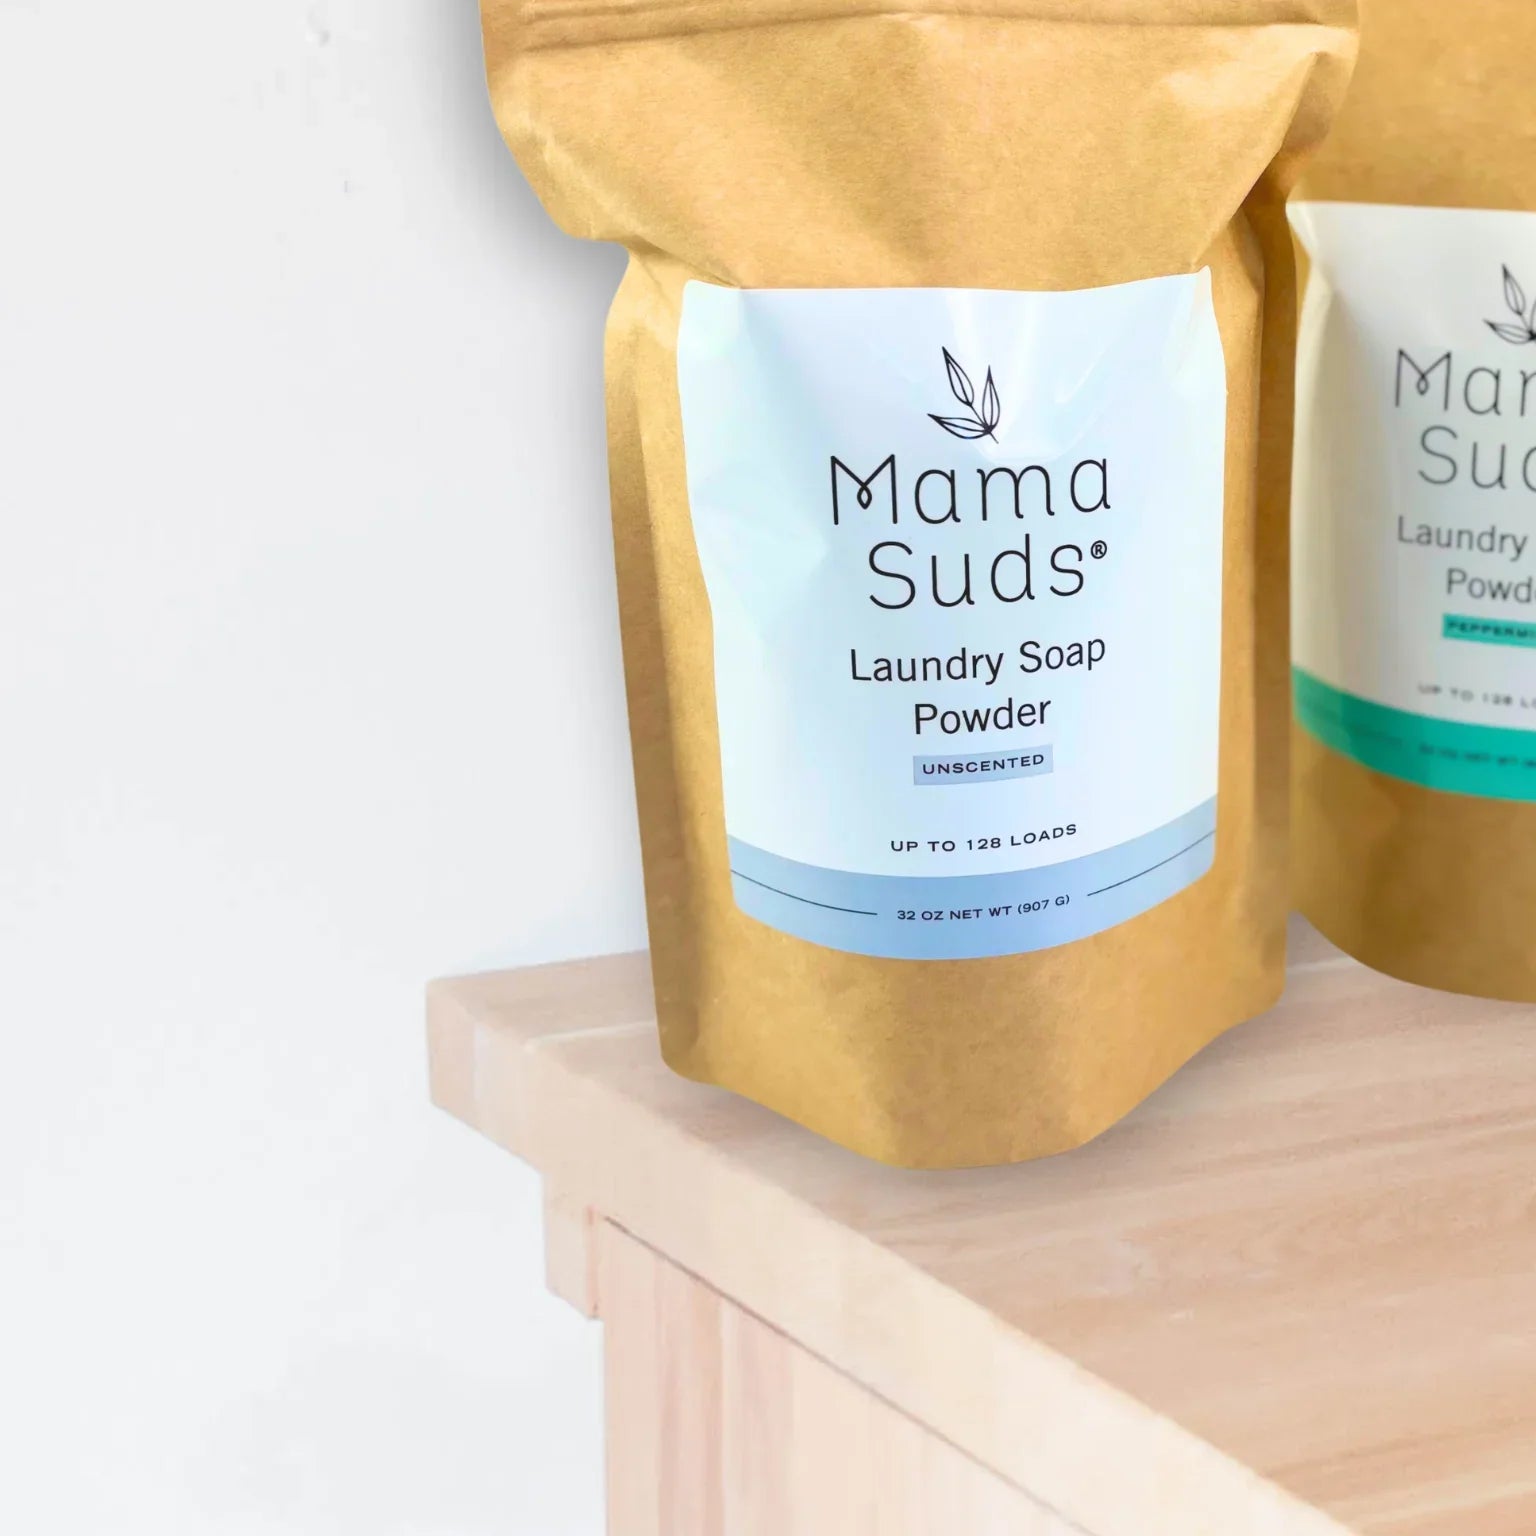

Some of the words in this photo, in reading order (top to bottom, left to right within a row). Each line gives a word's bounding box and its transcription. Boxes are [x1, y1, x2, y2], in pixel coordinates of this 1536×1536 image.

[829, 453, 1111, 526] Mama
[1397, 514, 1528, 563] Laundry
[850, 645, 1004, 686] Laundry
[1018, 637, 1106, 676] Soap
[914, 696, 1051, 735] Powder
[922, 754, 1045, 775] UNSCENTED
[890, 840, 918, 852] UP
[927, 840, 956, 852] TO
[966, 837, 1001, 850] 128
[1010, 823, 1077, 846] LOADS
[897, 910, 916, 921] 32
[921, 910, 944, 921] OZ
[949, 908, 983, 920] NET
[988, 905, 1013, 917] WT
[1017, 899, 1050, 915] (907
[1054, 894, 1070, 909] G)
